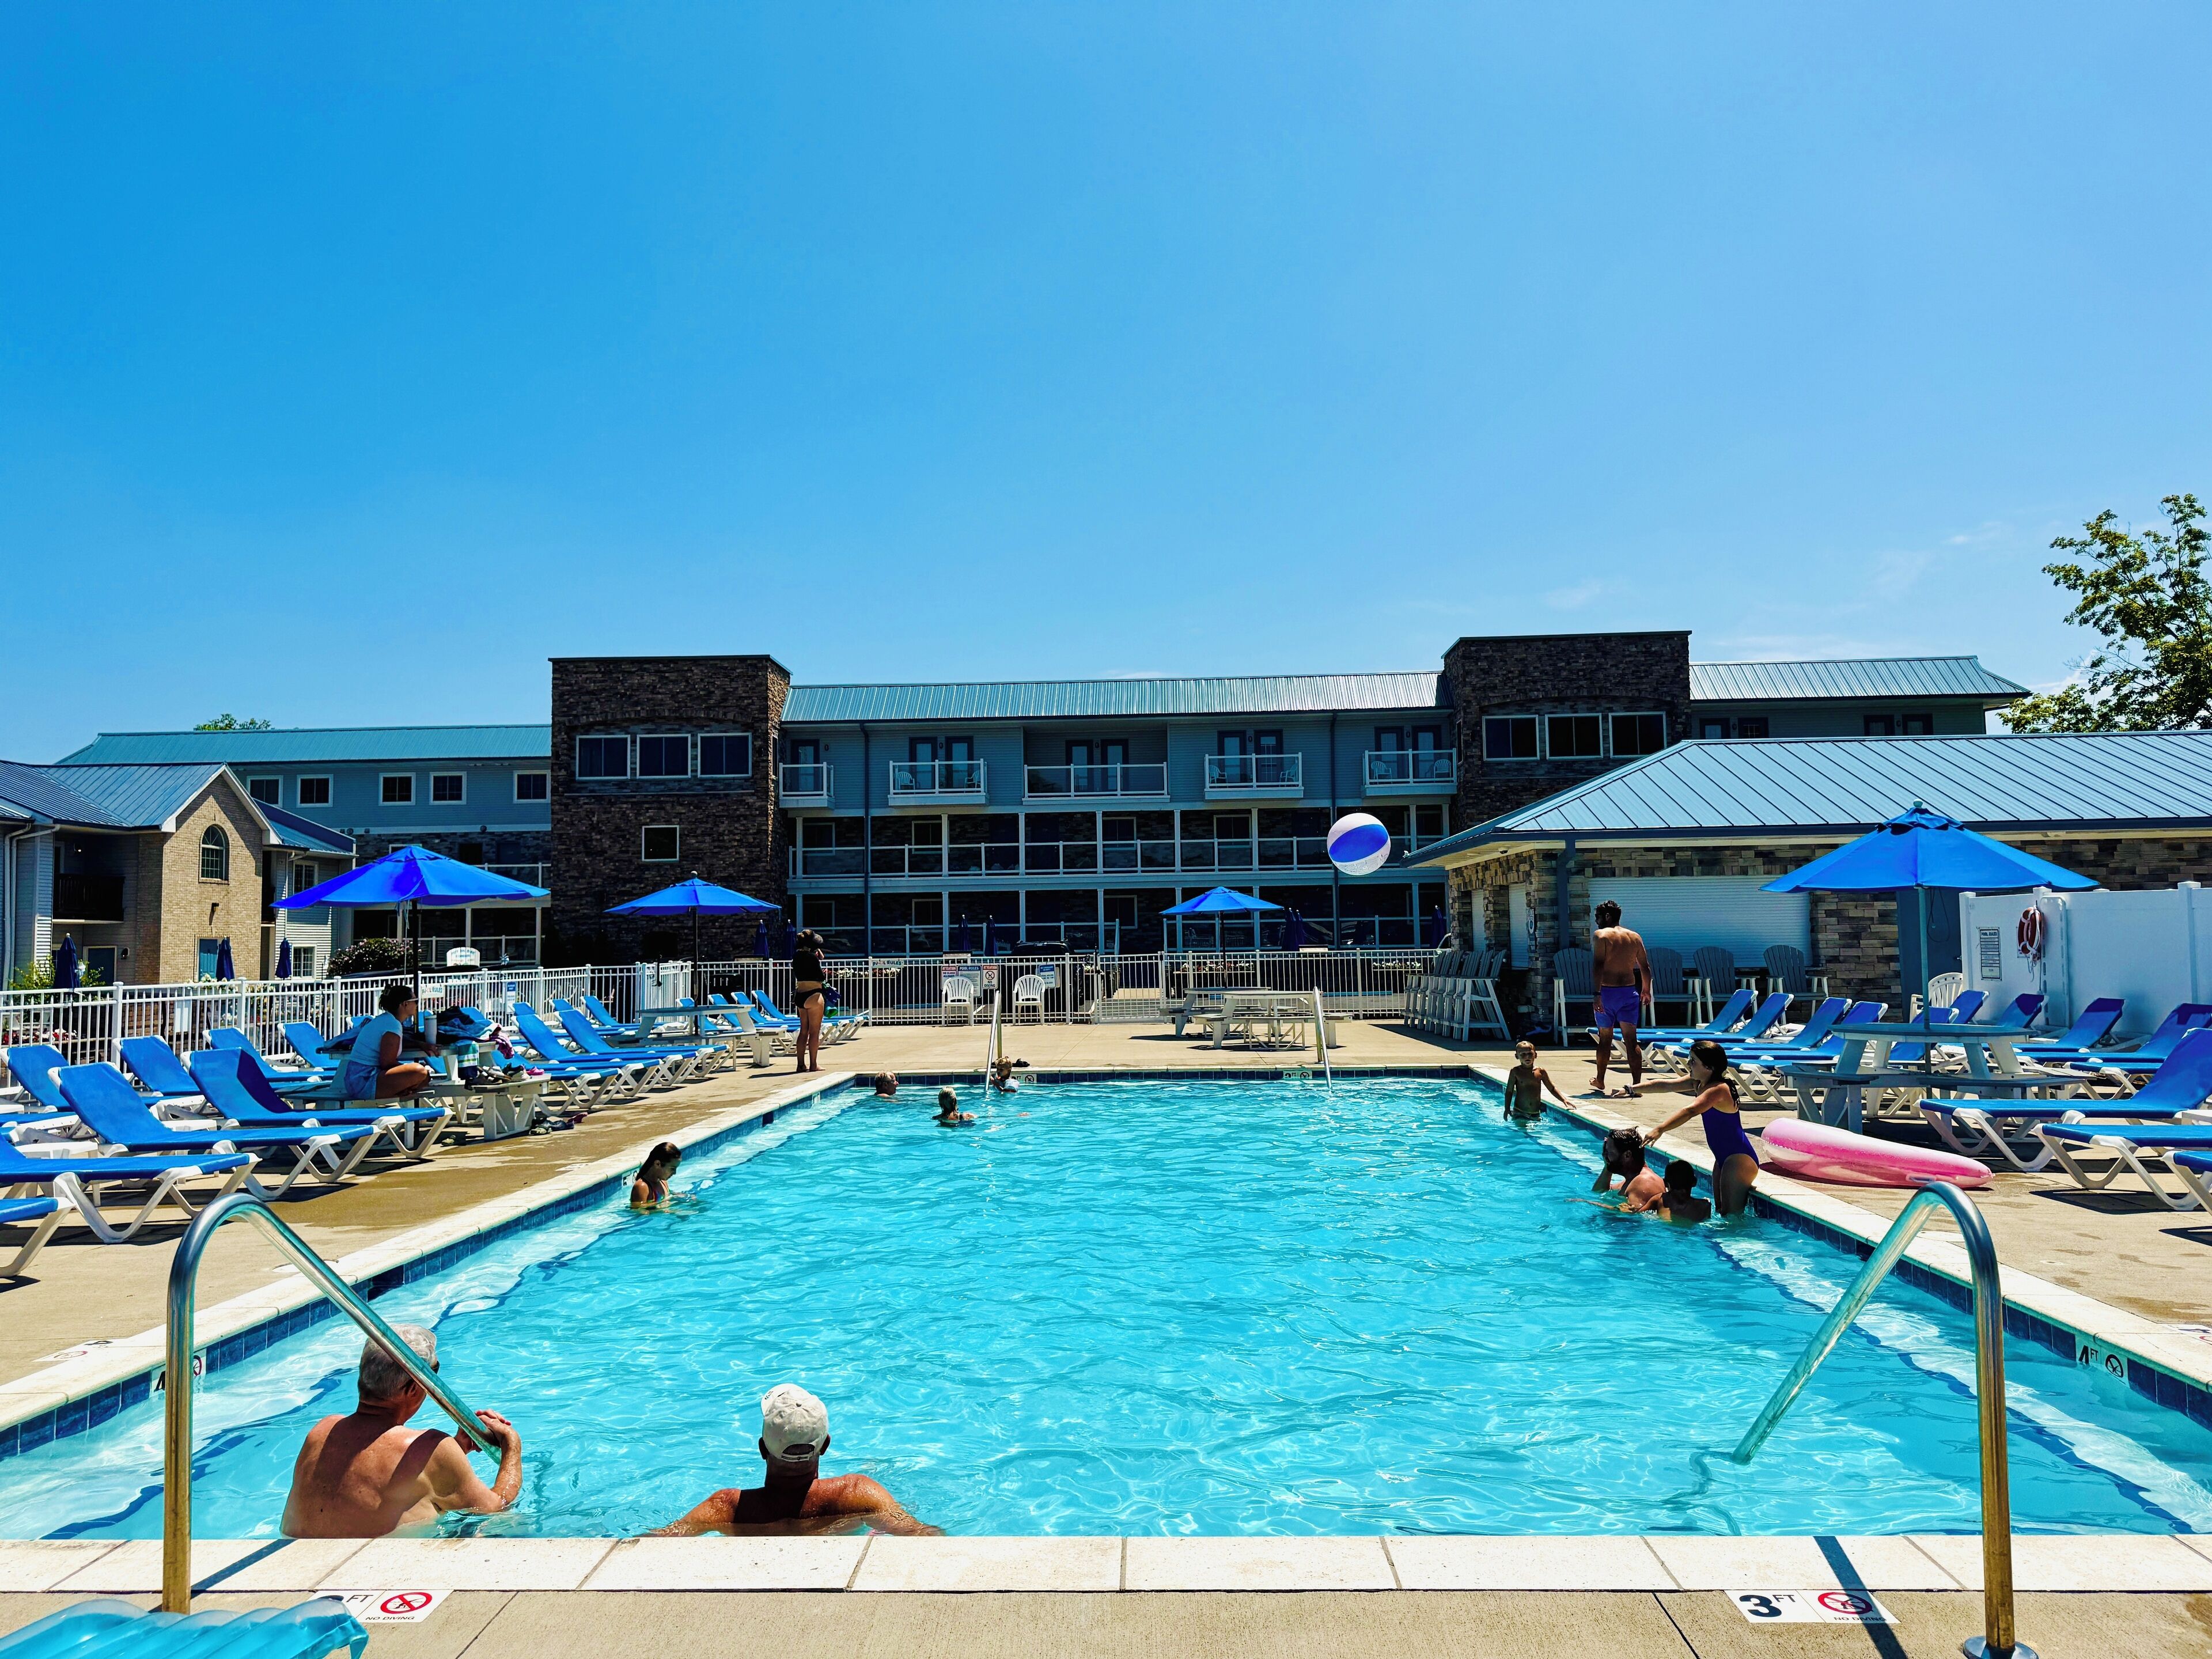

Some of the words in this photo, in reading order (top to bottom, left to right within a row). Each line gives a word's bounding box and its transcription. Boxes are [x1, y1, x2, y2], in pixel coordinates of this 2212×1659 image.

[2090, 1348, 2099, 1362] FT
[346, 1594, 373, 1603] FT
[1739, 1594, 1782, 1618] 3
[1772, 1594, 1795, 1603] FT
